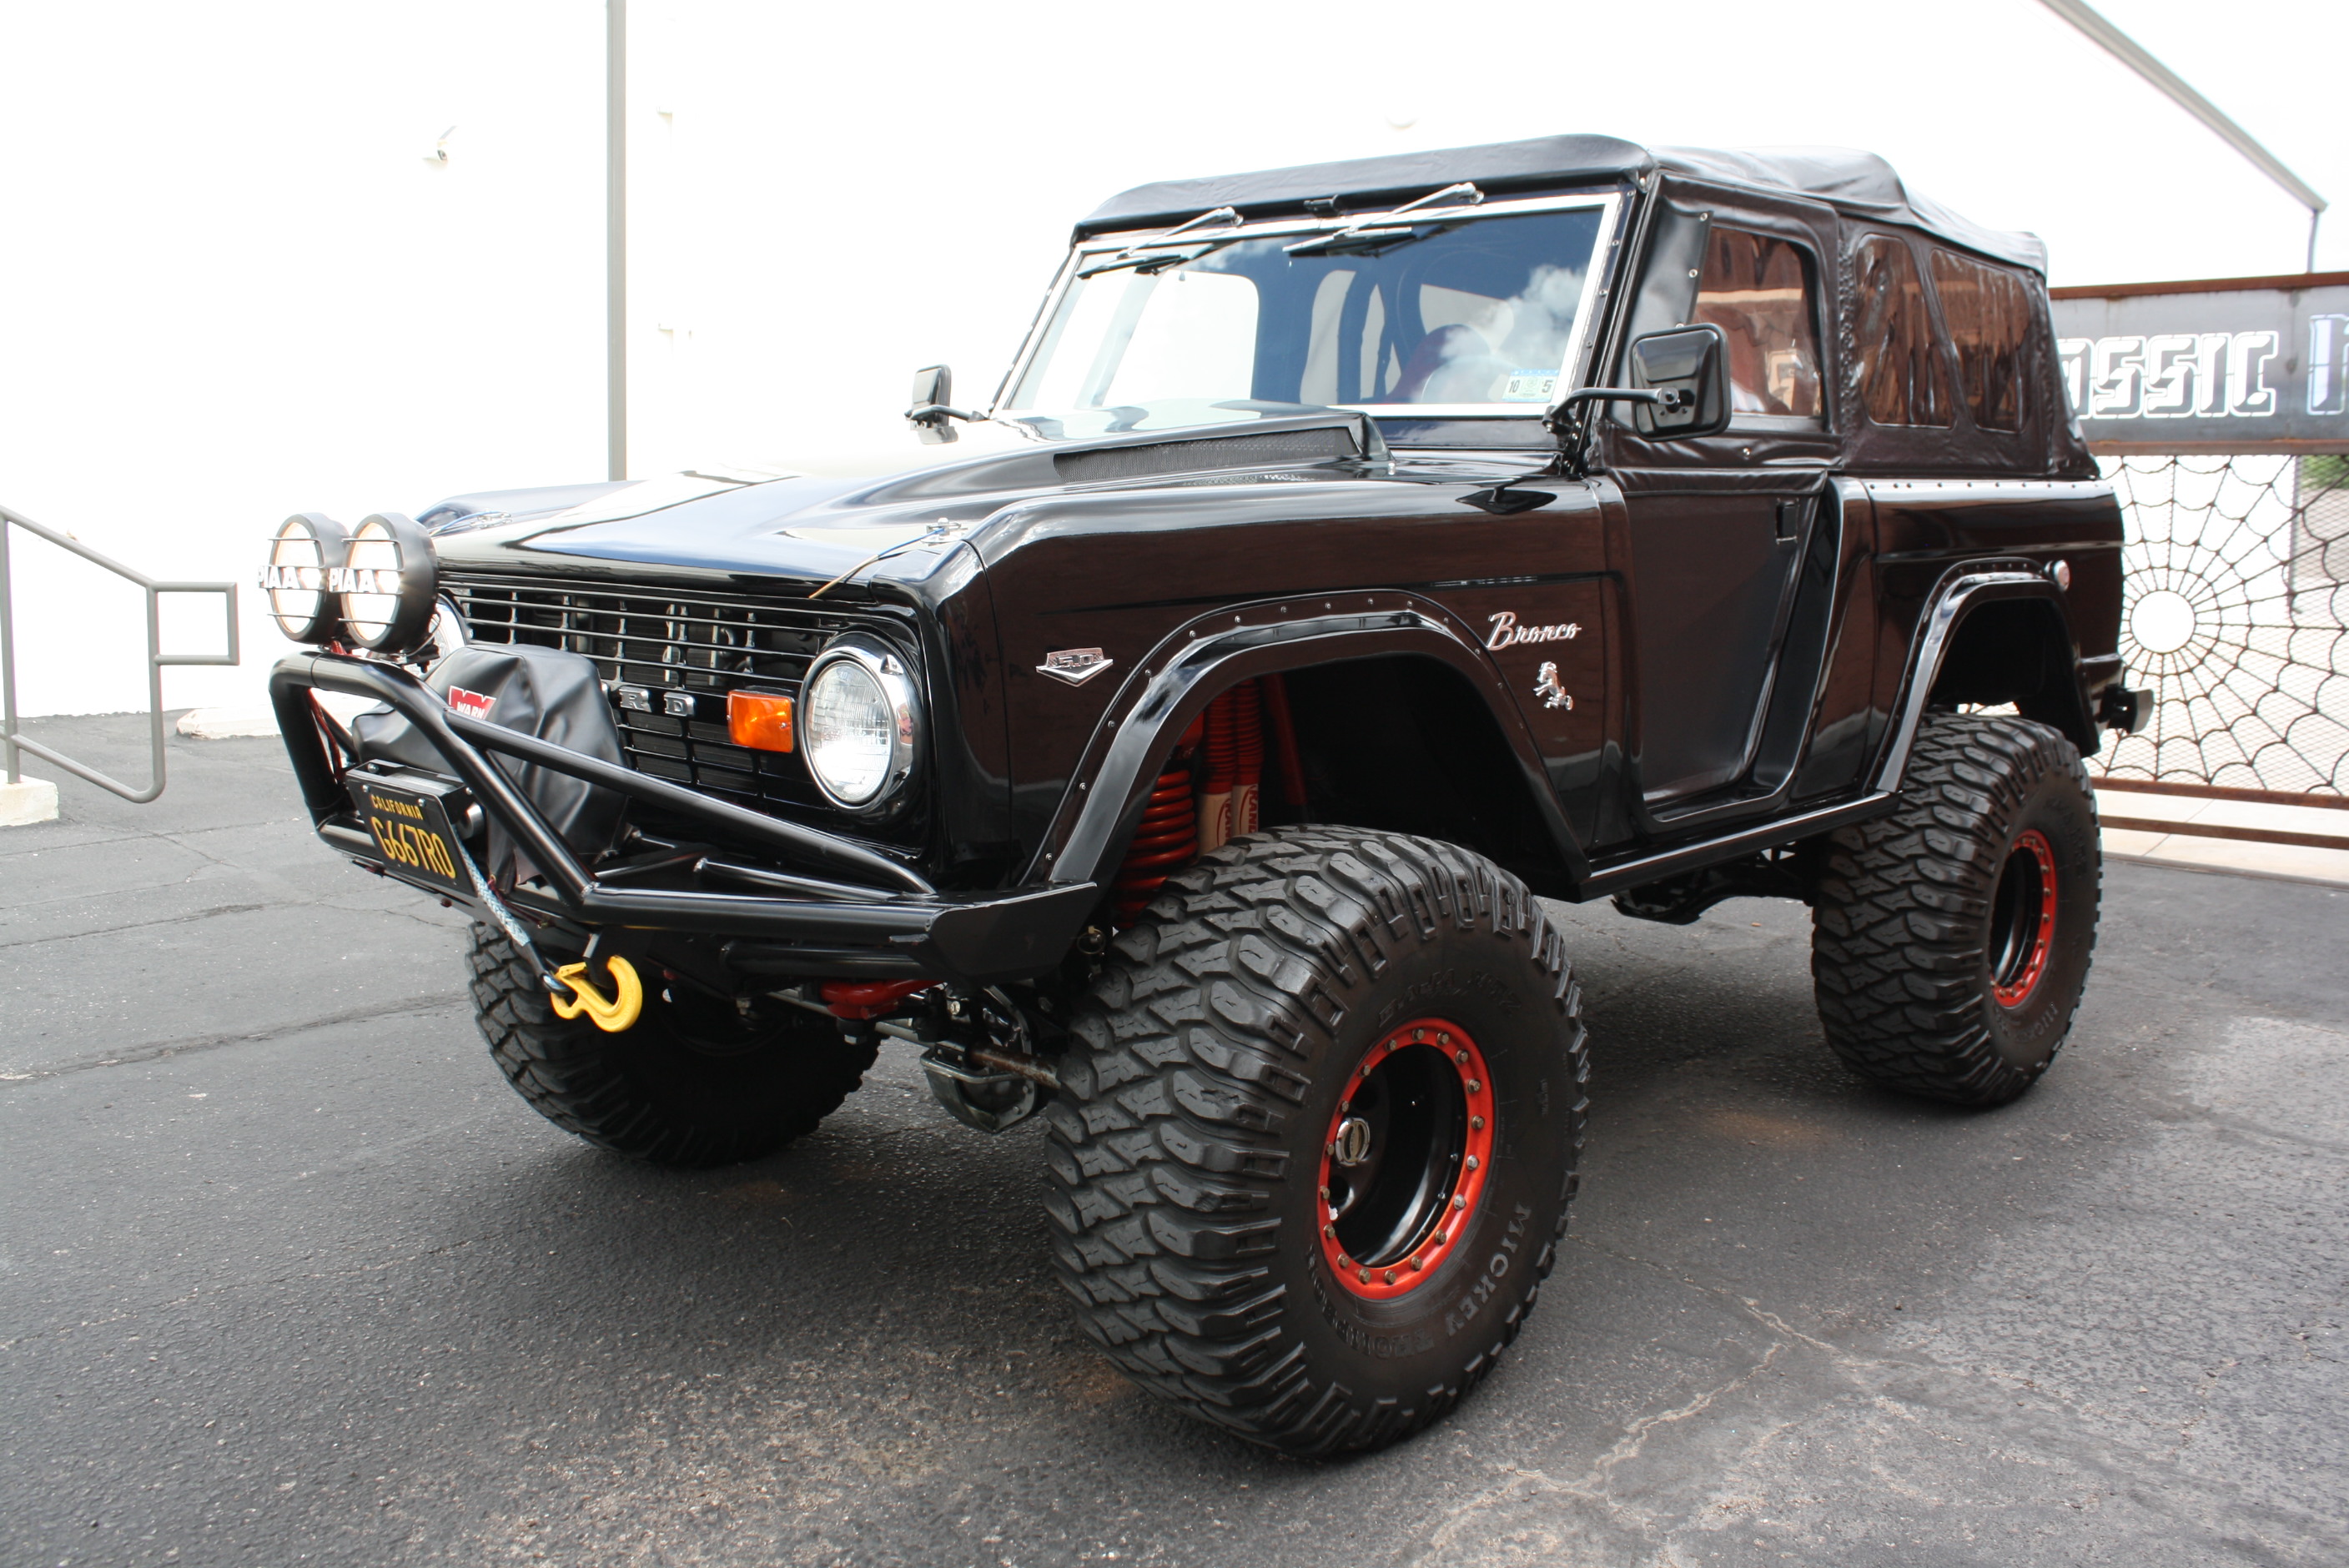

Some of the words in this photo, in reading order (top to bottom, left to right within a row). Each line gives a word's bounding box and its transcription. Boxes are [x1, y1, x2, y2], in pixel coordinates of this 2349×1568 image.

[1508, 379, 1520, 394] 10
[258, 565, 302, 590] PIAA
[329, 567, 378, 594] PIAA
[1485, 611, 1582, 651] Bronco
[456, 701, 485, 720] WARN
[370, 793, 423, 820] CALIFORNIA
[1445, 1201, 1532, 1337] MICKEY
